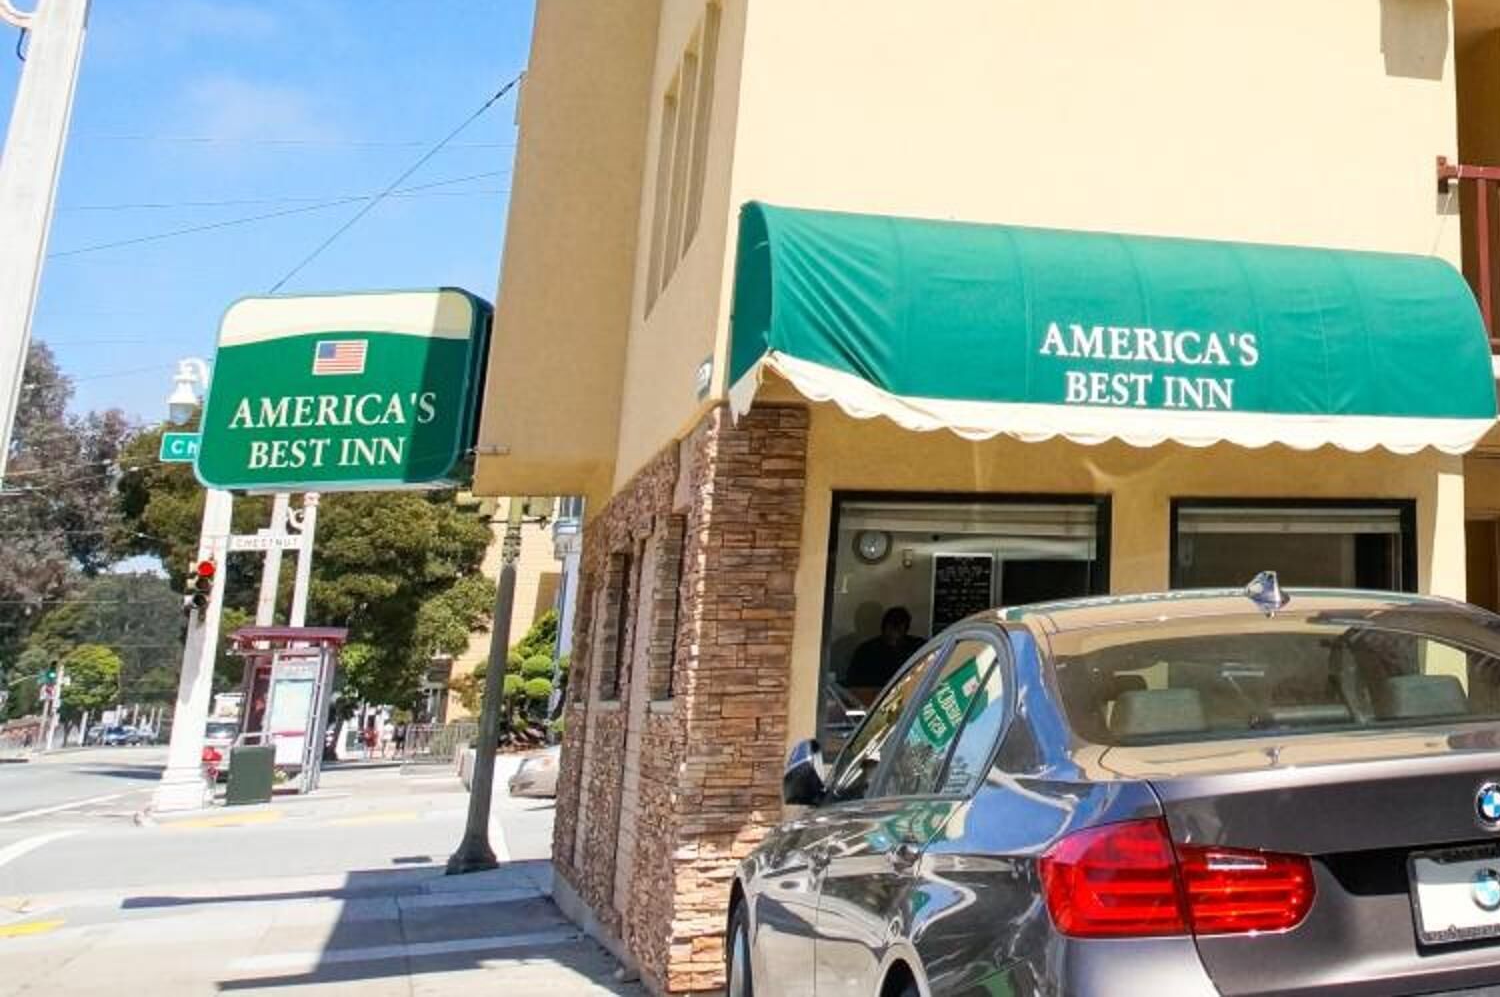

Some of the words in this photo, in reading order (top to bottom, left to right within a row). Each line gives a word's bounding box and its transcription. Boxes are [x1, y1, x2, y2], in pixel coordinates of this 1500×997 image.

[1039, 321, 1260, 367] AMERICA'S
[1064, 370, 1153, 406] BEST
[1162, 375, 1235, 410] INN
[228, 391, 437, 430] AMERICA'S
[247, 438, 330, 470] BEST
[337, 436, 406, 467] INN
